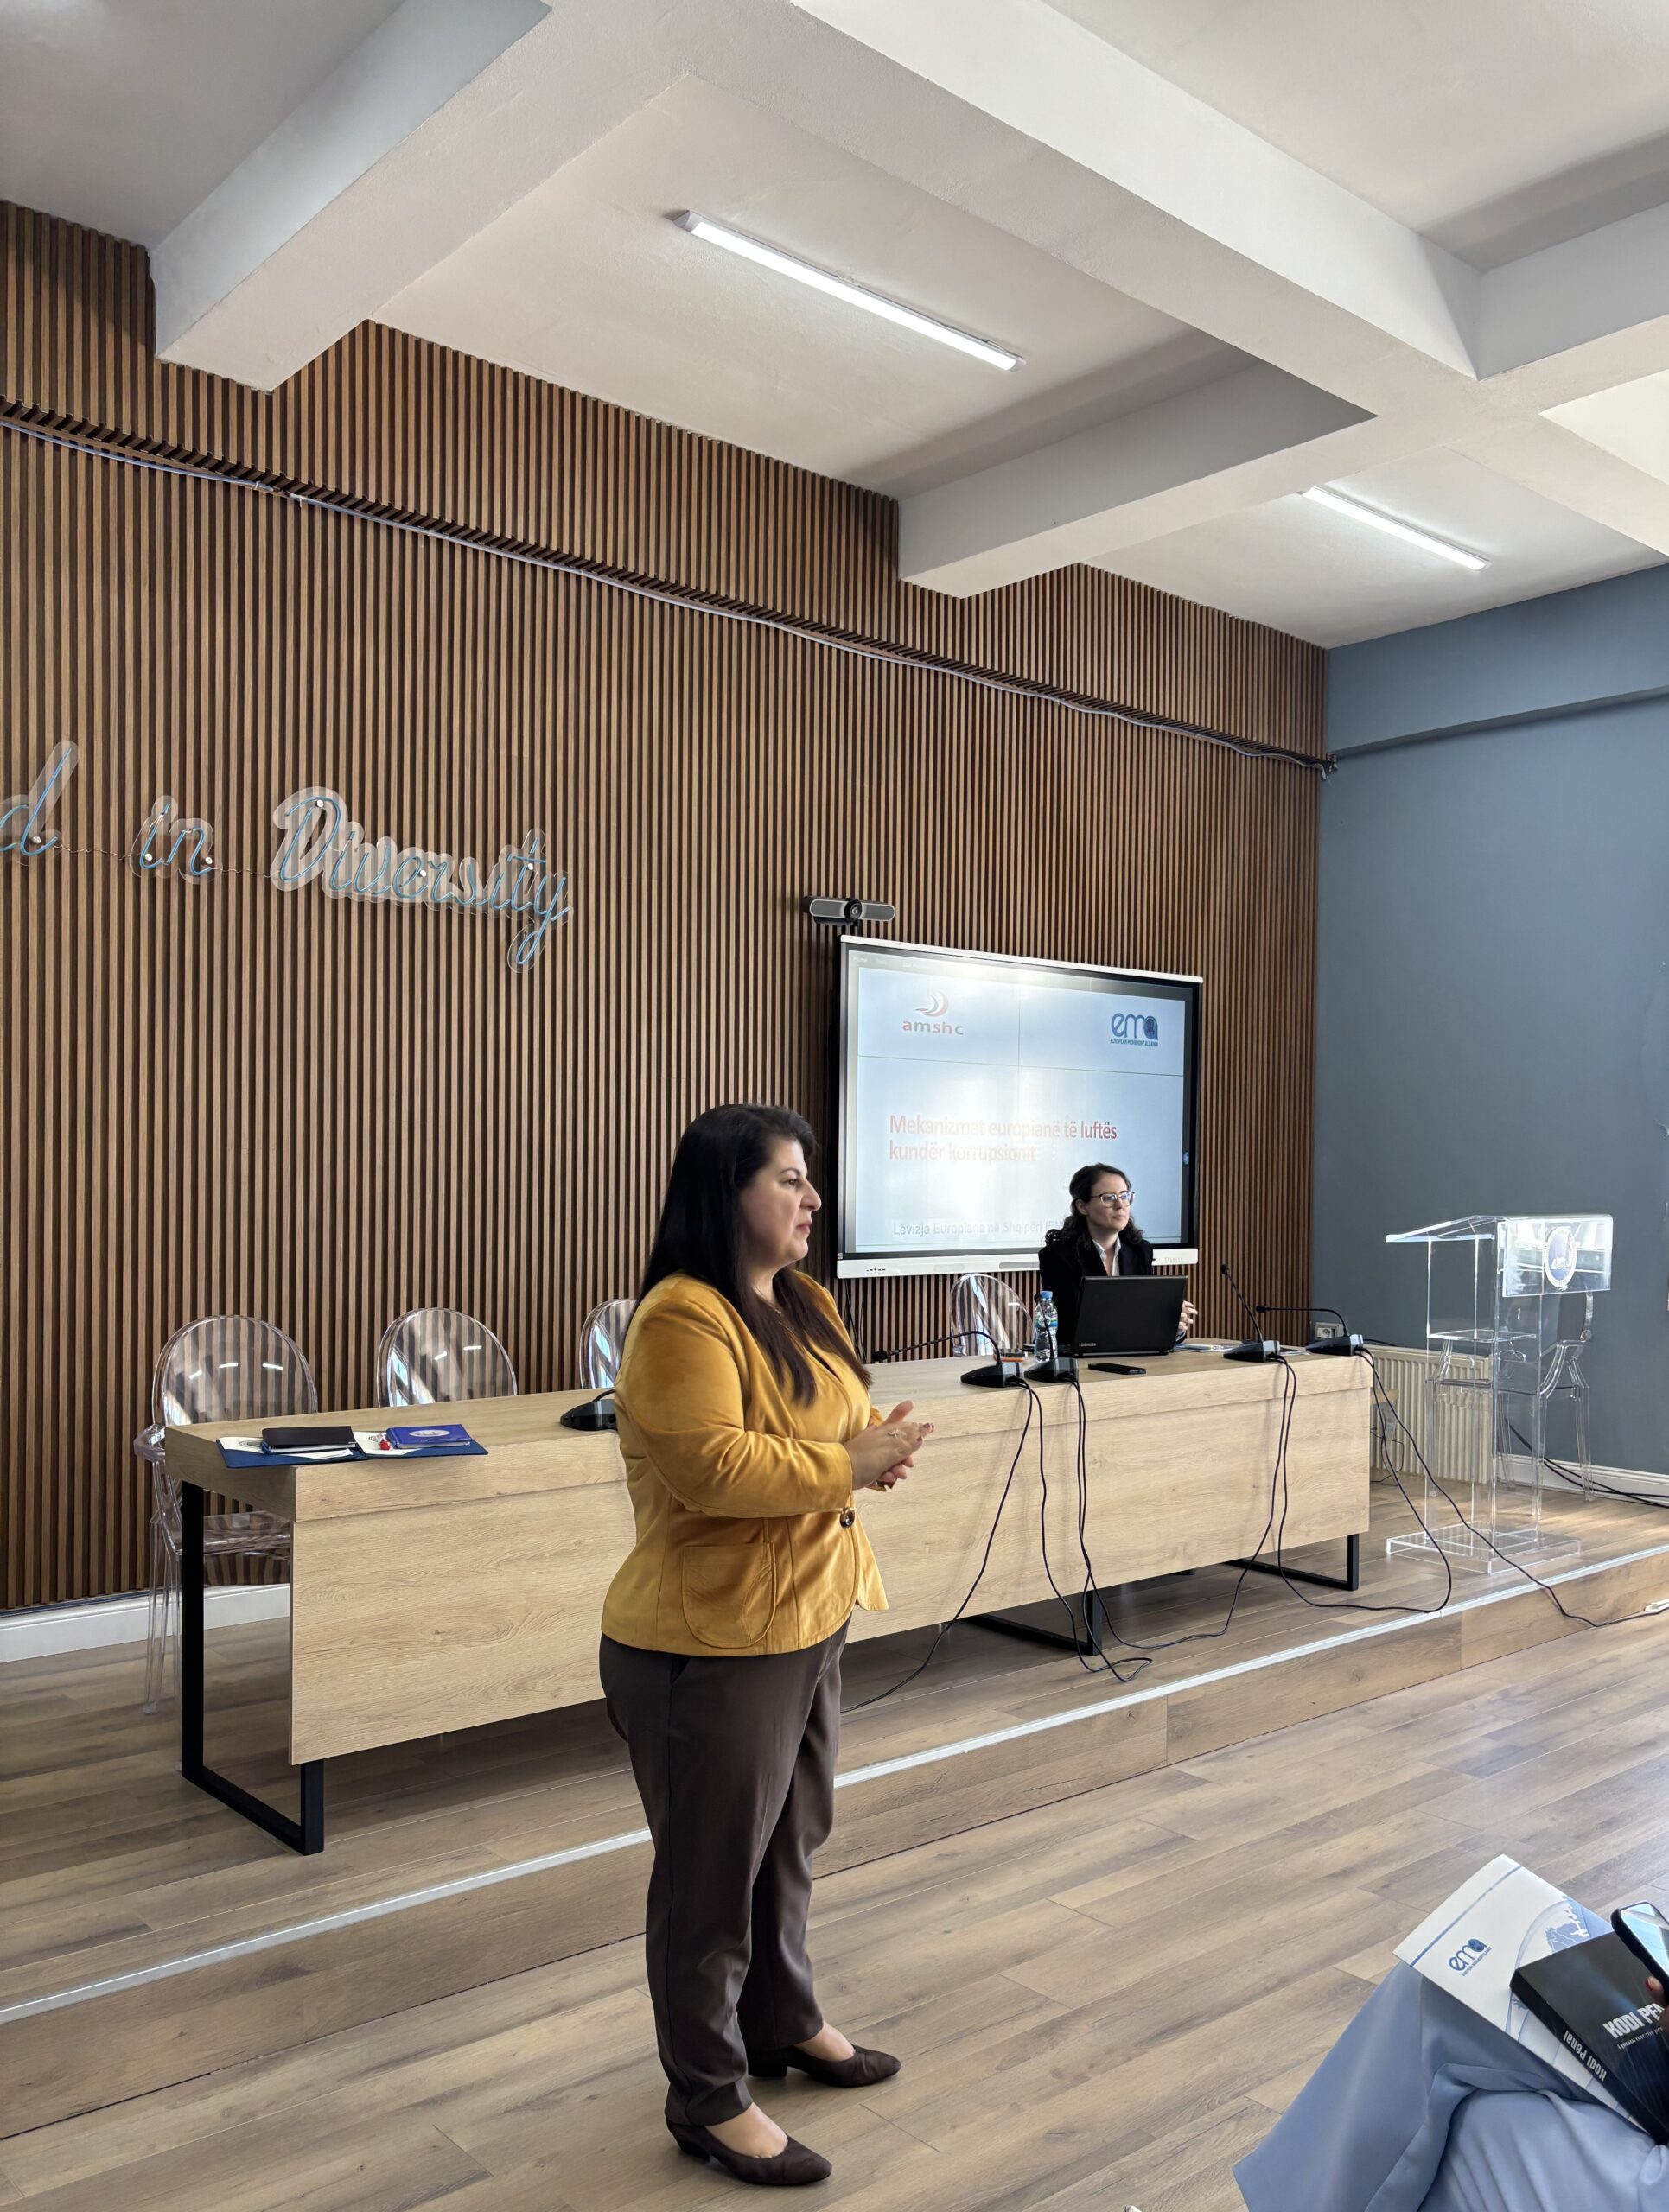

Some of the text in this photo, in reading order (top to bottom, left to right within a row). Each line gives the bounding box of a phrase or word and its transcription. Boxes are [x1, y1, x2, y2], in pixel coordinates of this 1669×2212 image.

[138, 802, 213, 877] in
[277, 792, 572, 968] Diversity
[901, 1020, 965, 1036] amshc
[1110, 1012, 1159, 1041] ema
[889, 1113, 1118, 1141] Mekanizmat europianë të luftës
[889, 1140, 946, 1160] kundër
[893, 1221, 930, 1237] Lëvizja
[1602, 2012, 1646, 2039] KODI
[1563, 2030, 1588, 2061] Penal
